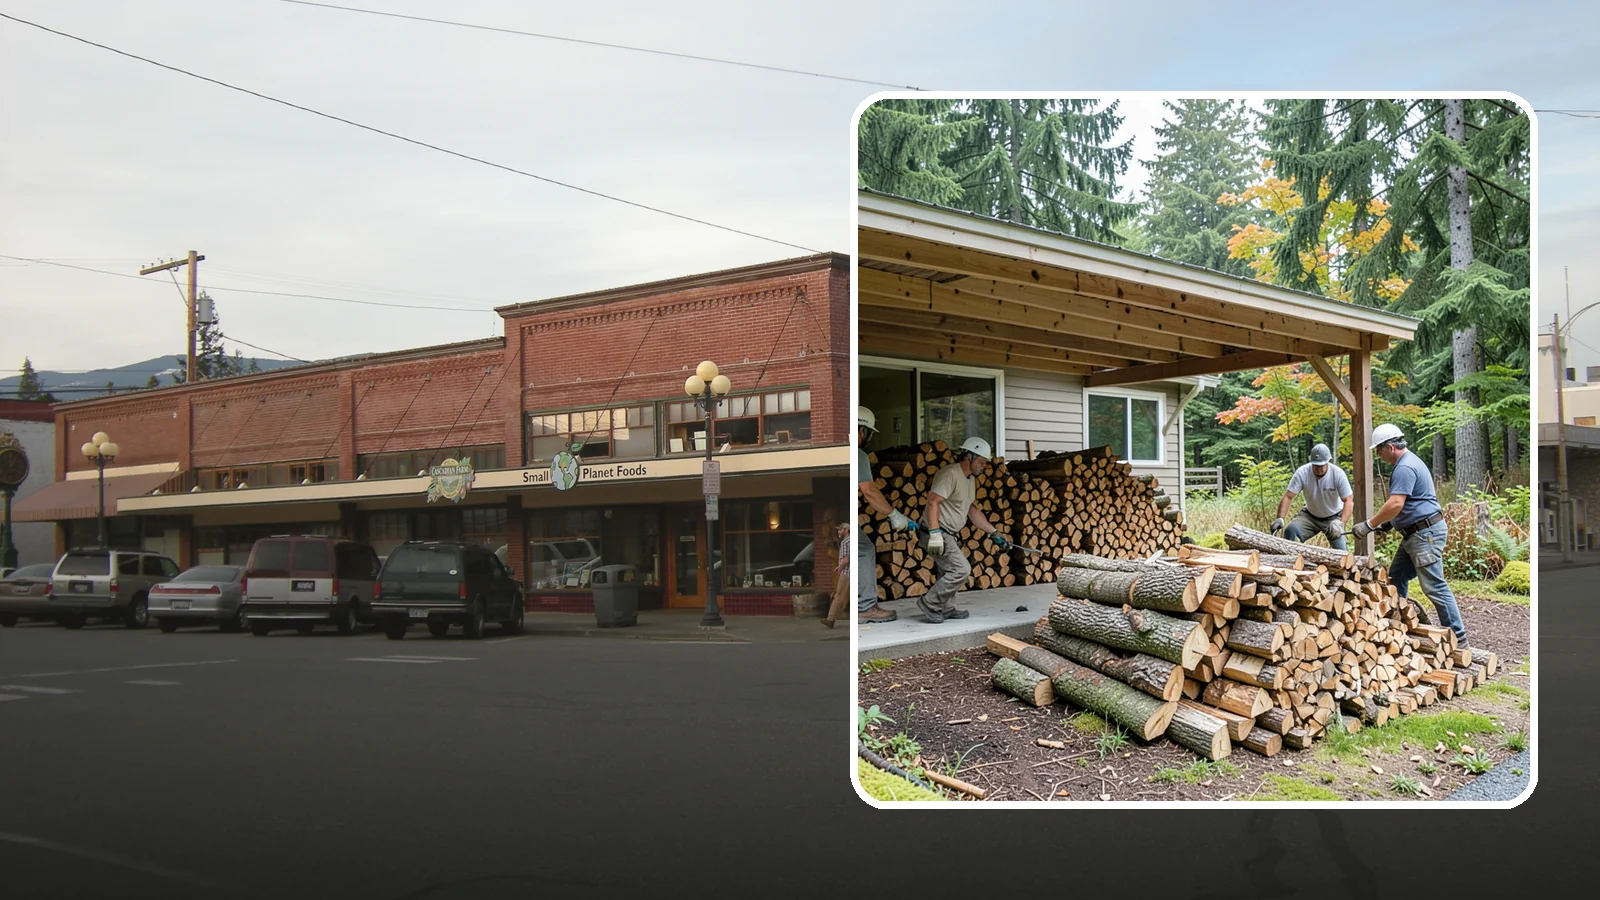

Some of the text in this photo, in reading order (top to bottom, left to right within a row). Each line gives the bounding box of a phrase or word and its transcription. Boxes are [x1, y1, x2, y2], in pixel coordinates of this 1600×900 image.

[523, 464, 647, 483] Small Planet Foods
